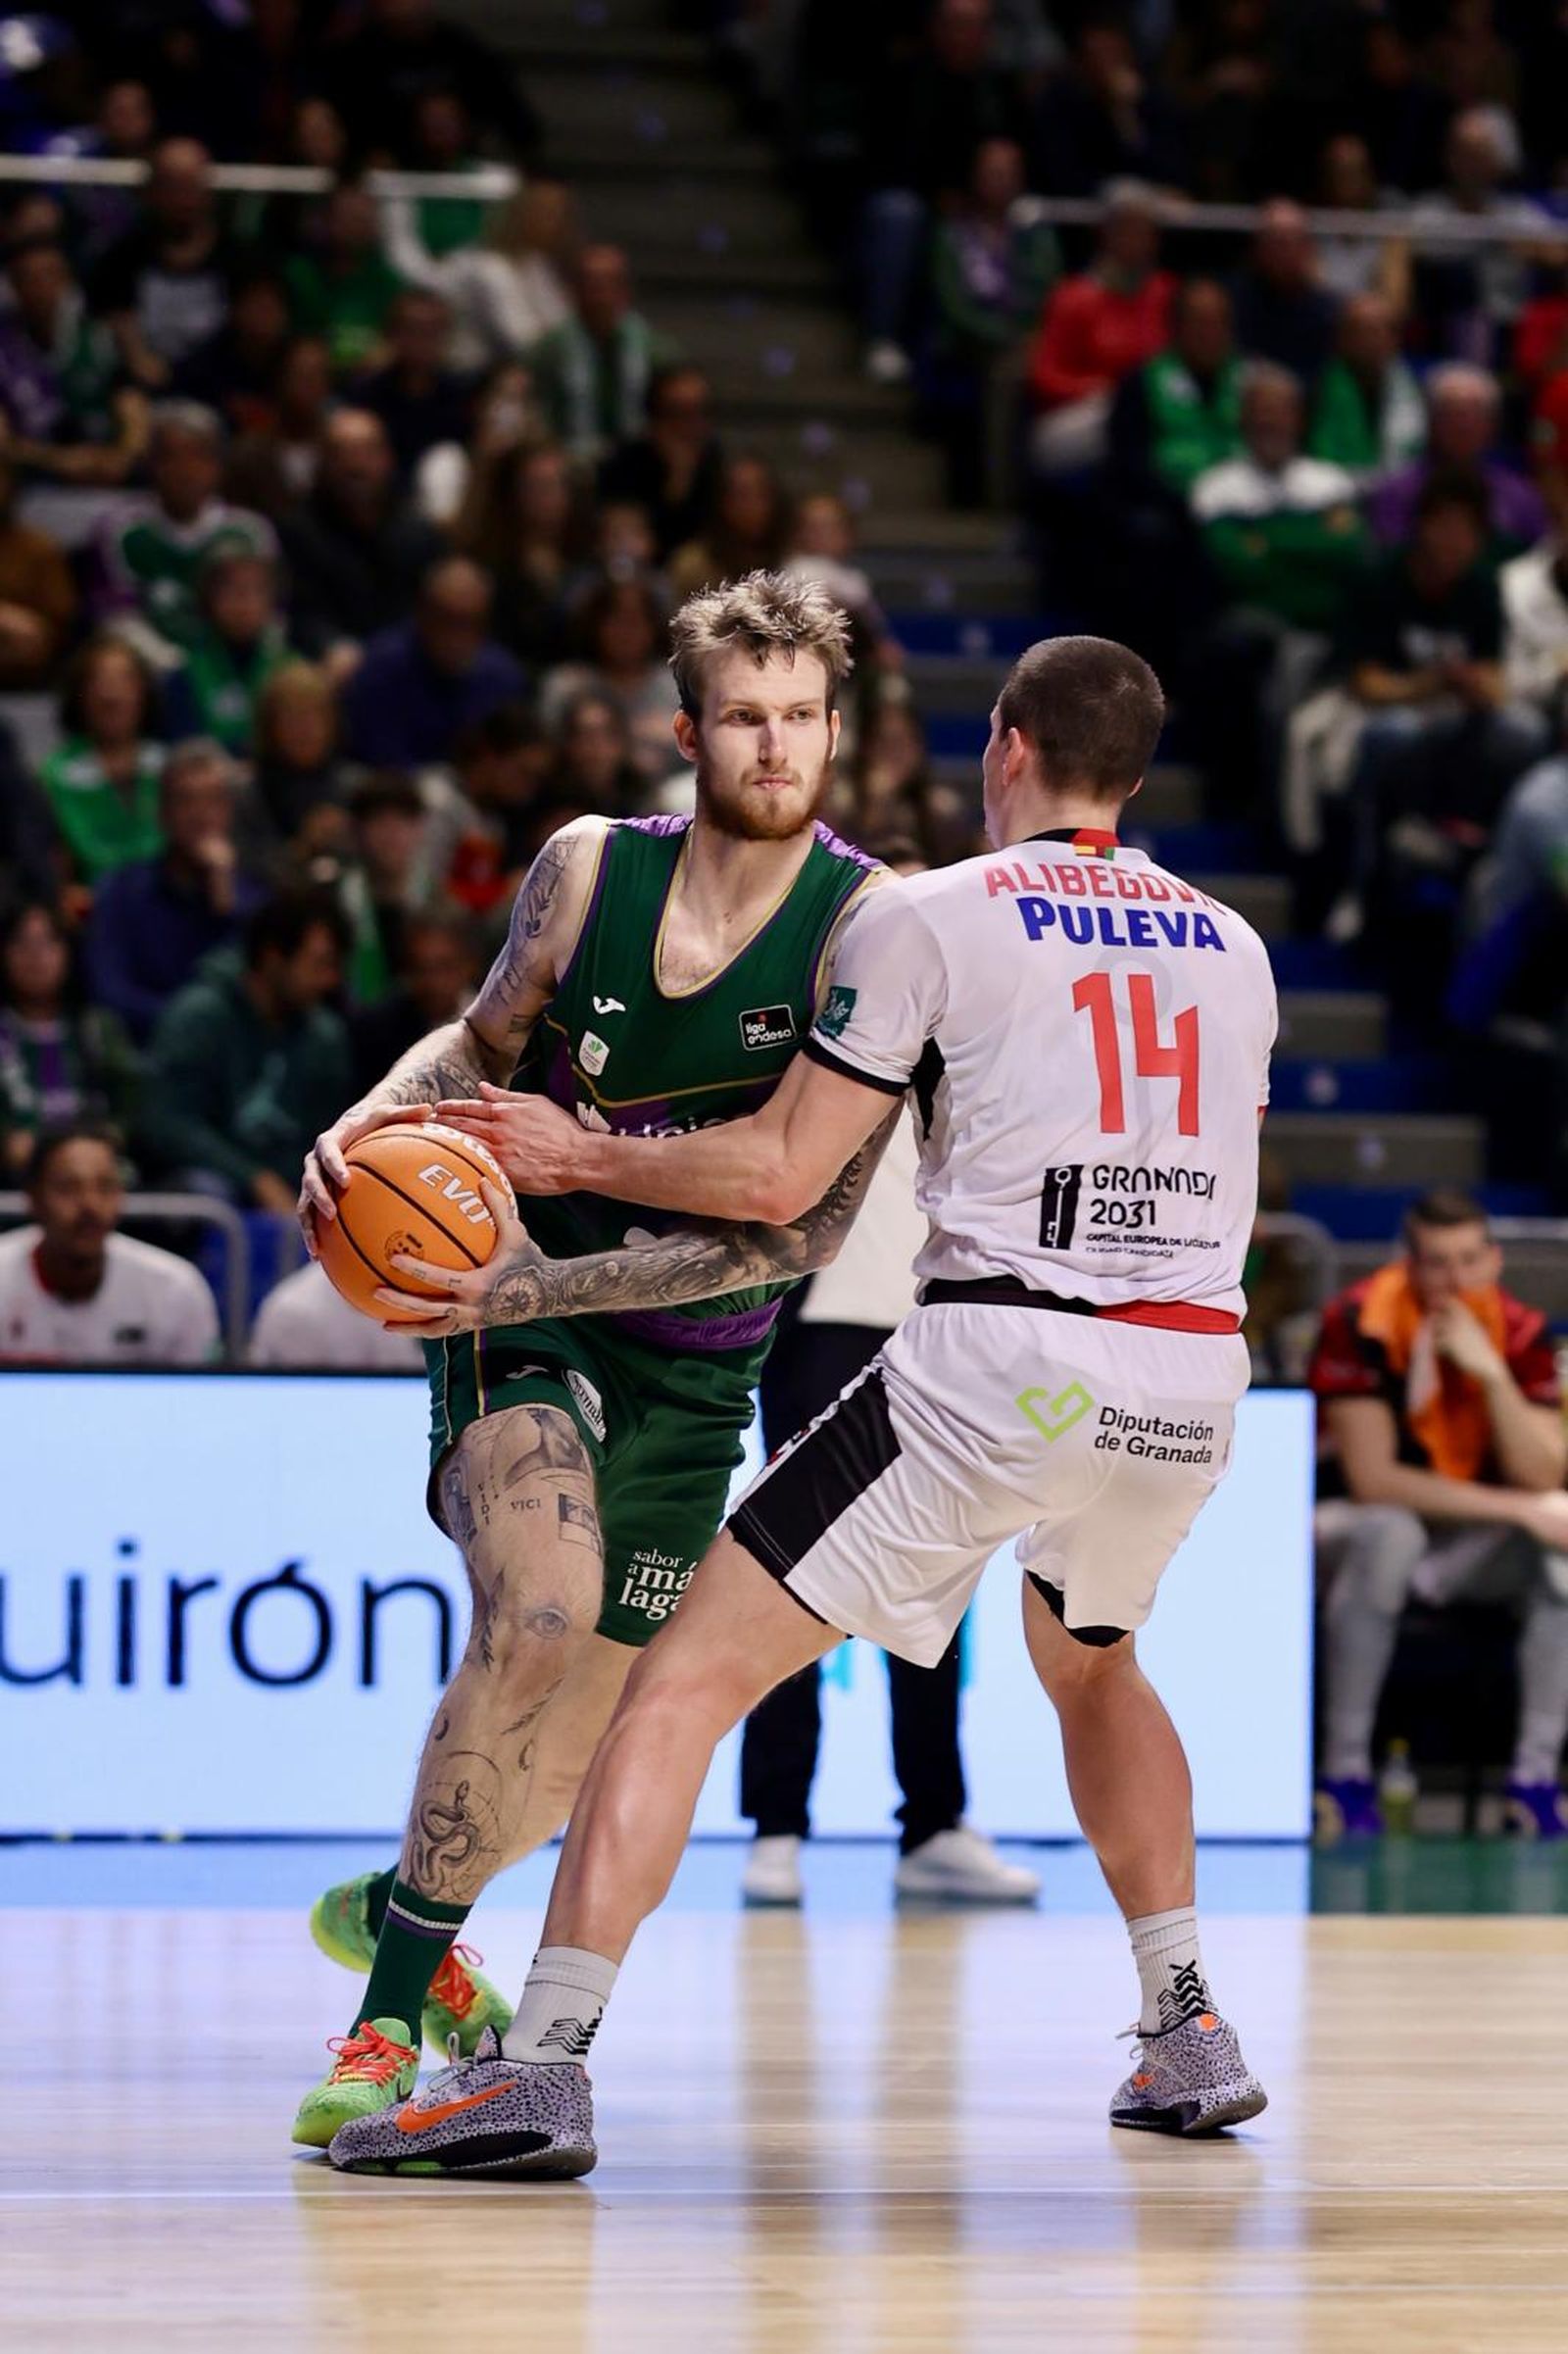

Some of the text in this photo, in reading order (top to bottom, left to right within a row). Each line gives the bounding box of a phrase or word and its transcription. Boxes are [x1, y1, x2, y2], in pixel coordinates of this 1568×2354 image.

[1016, 897, 1227, 953] PULEVA
[745, 1022, 766, 1035] liga
[748, 1029, 793, 1046] endesa
[1072, 972, 1200, 1137] 14
[418, 1164, 490, 1224] EVO
[1090, 1199, 1156, 1229] 2031
[1123, 1234, 1168, 1247] EUROPEA
[1099, 1406, 1214, 1442] Diputación
[1095, 1431, 1213, 1464] de Granada
[632, 1548, 683, 1568] sabor
[627, 1561, 698, 1592] a má
